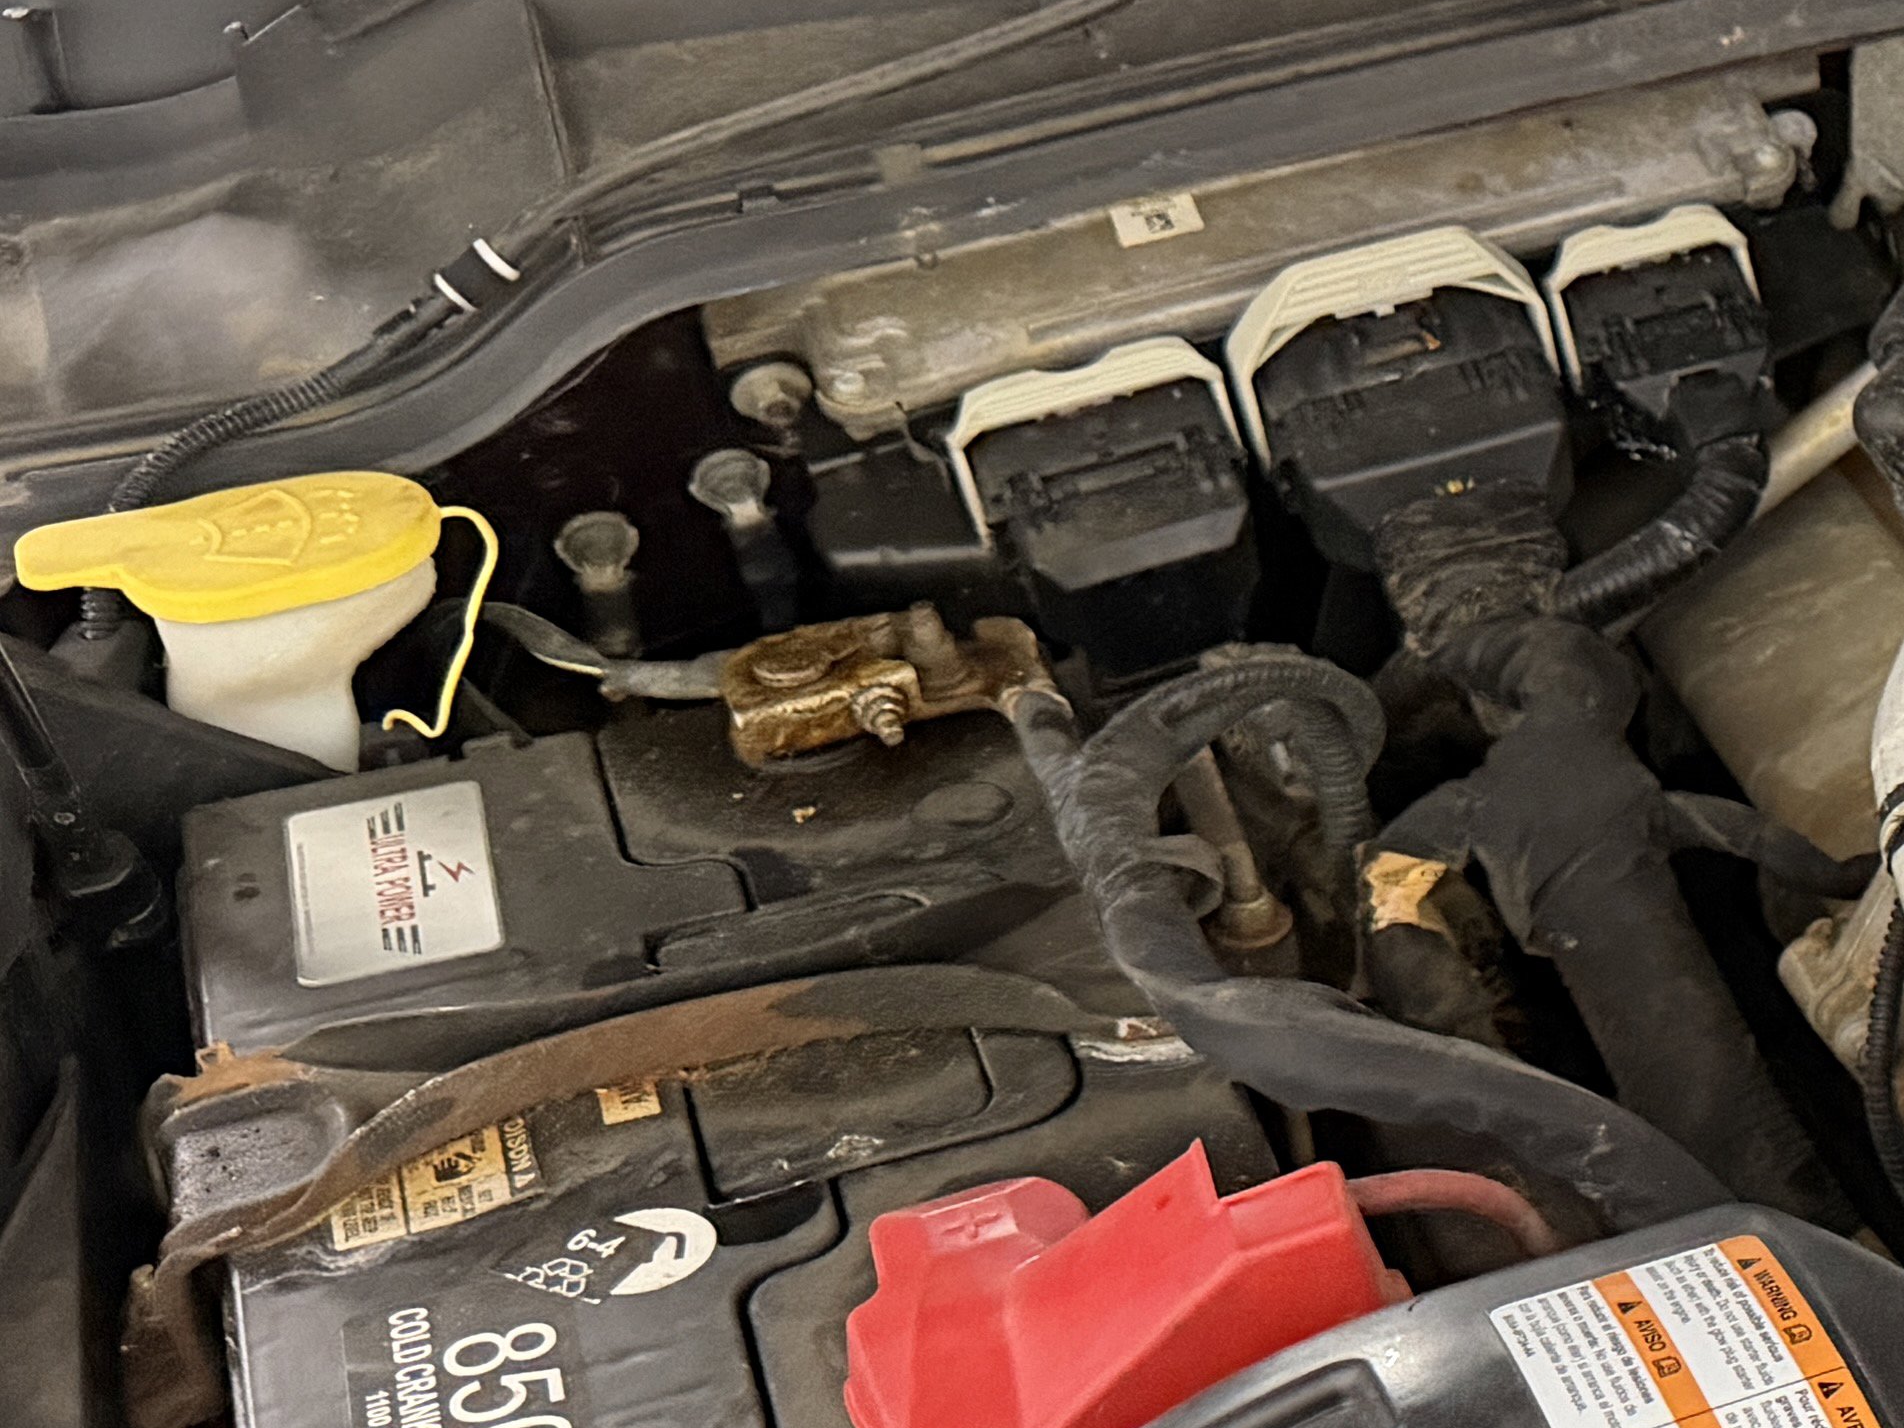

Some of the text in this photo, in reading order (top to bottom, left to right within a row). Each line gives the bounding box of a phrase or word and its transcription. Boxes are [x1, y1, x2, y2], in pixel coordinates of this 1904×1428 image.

[370, 833, 417, 927] ULTRA POWER
[567, 1228, 626, 1258] 6-4
[1751, 1269, 1799, 1321] WARNING
[388, 1307, 433, 1364] COLD
[1632, 1316, 1668, 1353] AVISO
[365, 1390, 393, 1428] 1100
